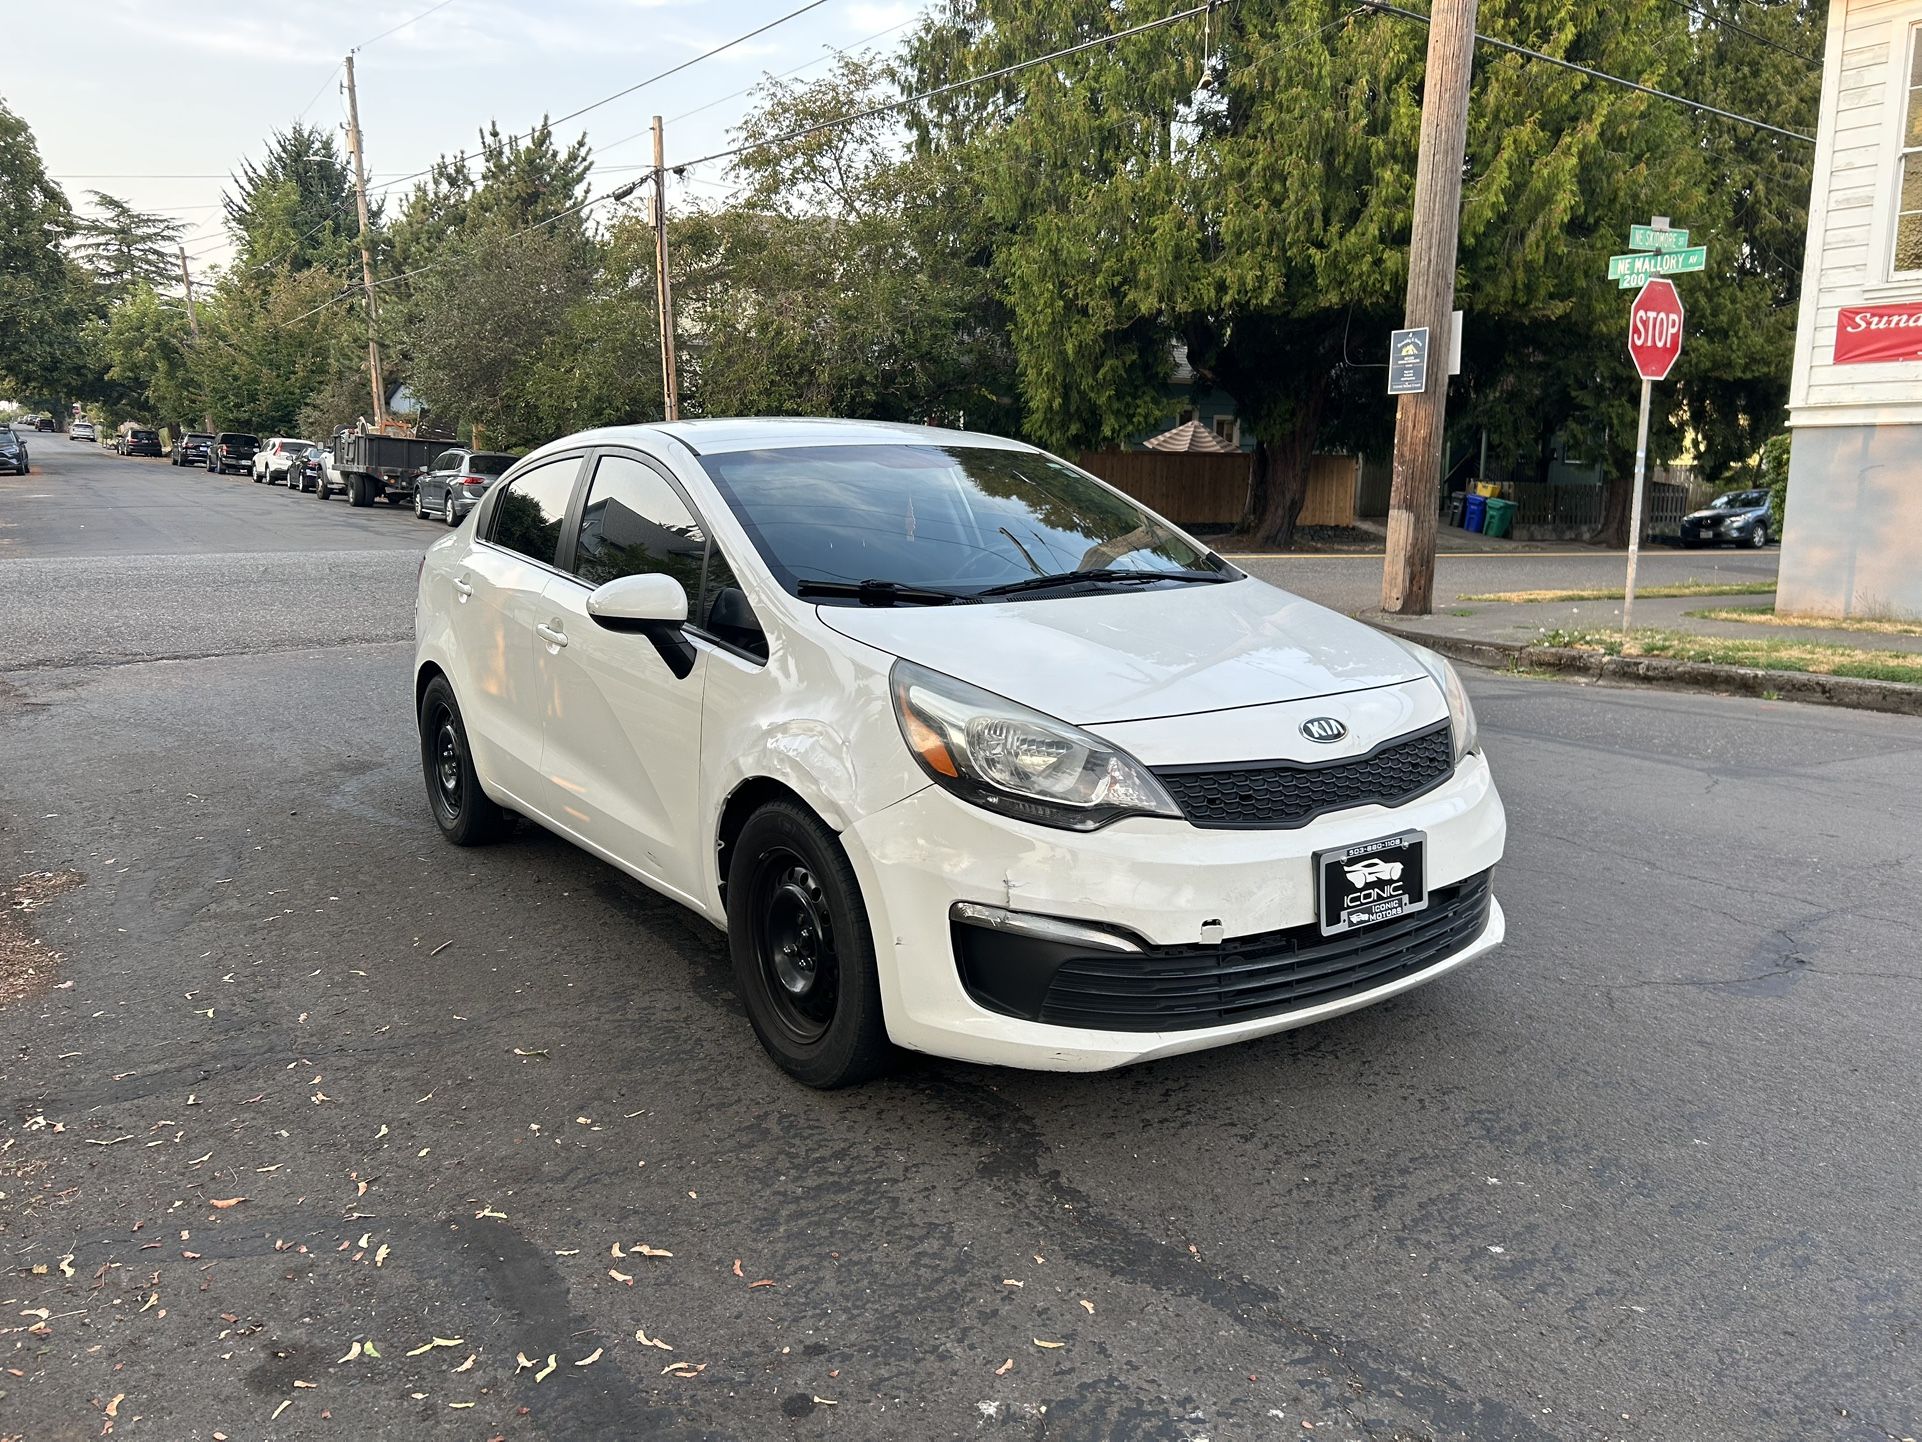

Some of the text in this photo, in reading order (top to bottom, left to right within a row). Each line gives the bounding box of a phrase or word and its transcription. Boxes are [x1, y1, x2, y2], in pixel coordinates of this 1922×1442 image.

[1634, 229, 1644, 245] NE
[1617, 253, 1698, 274] NE MALLORY AV
[1622, 273, 1645, 287] 200
[1633, 309, 1680, 348] STOP
[1305, 719, 1345, 738] KIA
[1343, 881, 1404, 908] ICONIC
[1369, 906, 1402, 922] MOTORS
[1371, 900, 1399, 913] ICONIC
